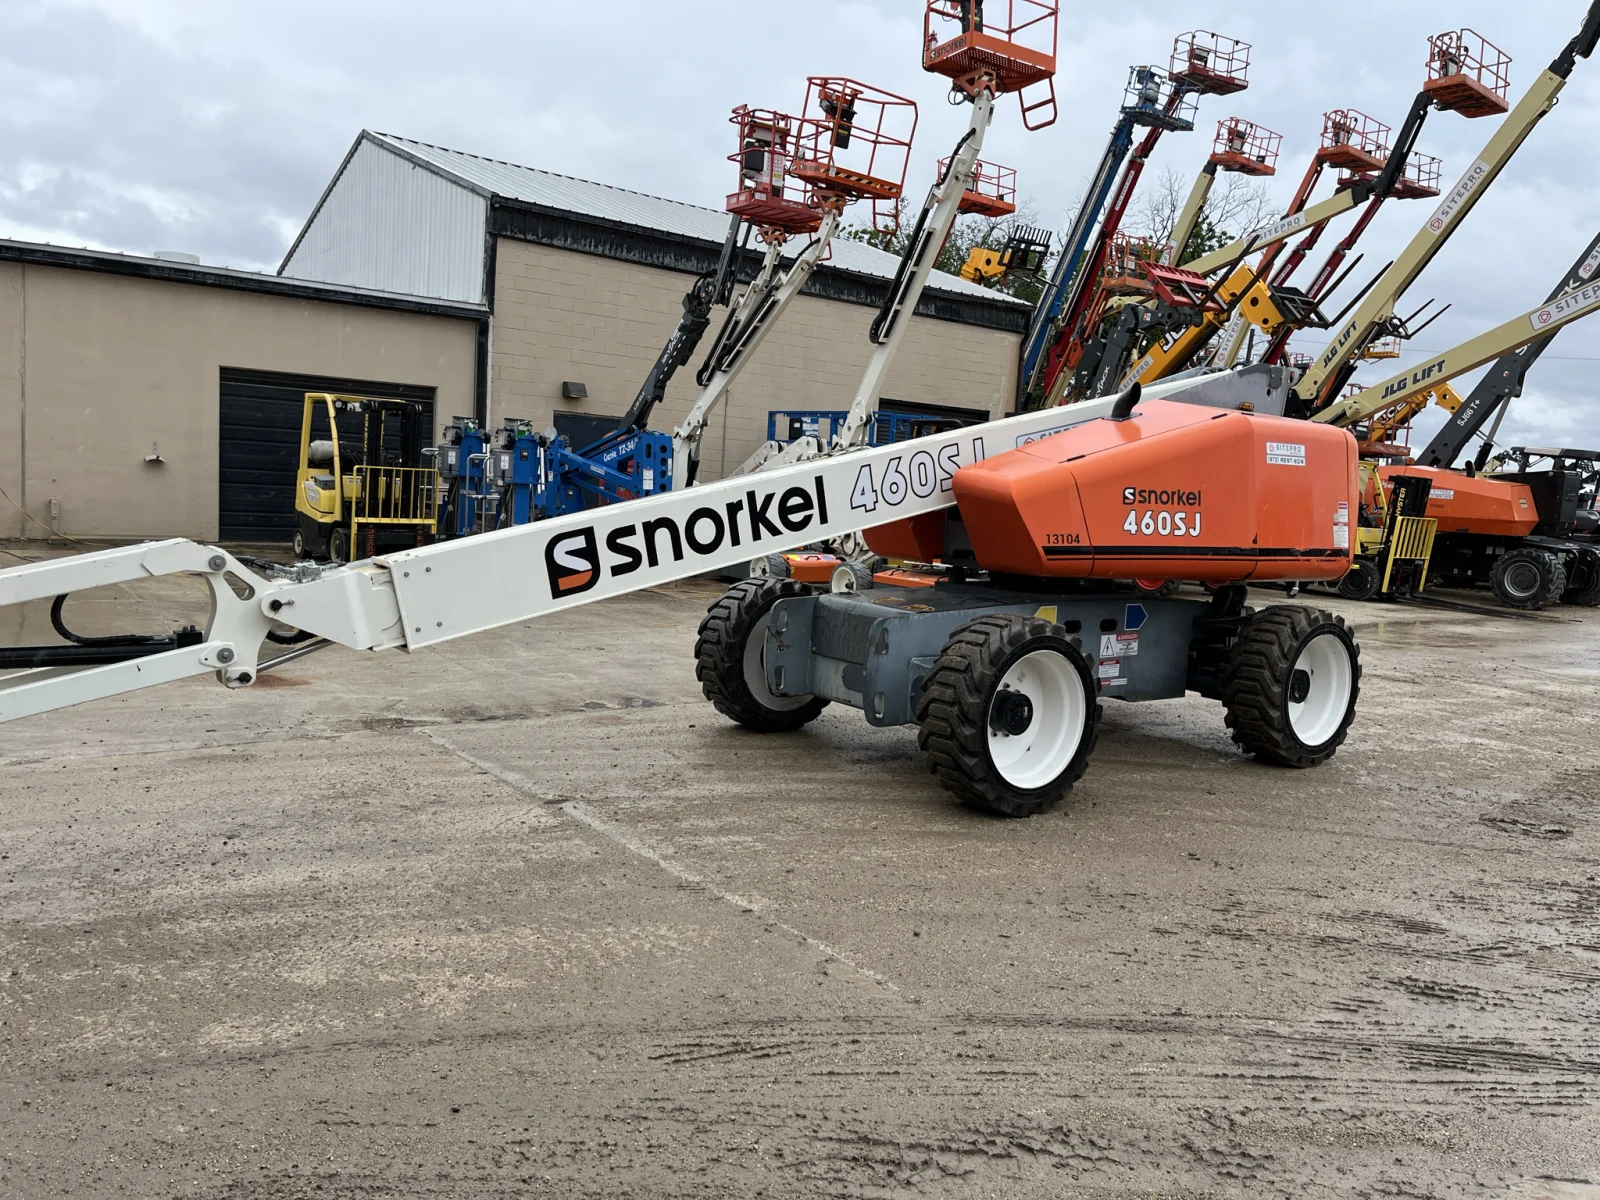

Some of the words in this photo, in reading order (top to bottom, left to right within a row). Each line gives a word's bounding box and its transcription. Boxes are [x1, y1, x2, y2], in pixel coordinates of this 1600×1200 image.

[936, 36, 967, 58] snorkel
[1441, 166, 1483, 217] SITEPRO
[1323, 345, 1338, 369] JLG
[1338, 320, 1357, 348] LIFT
[1123, 360, 1150, 390] SITEPRO
[1381, 377, 1408, 400] JLG
[1412, 359, 1446, 385] LIFT
[1457, 408, 1474, 426] SJ66
[1275, 444, 1302, 452] SITEPRO
[1138, 489, 1202, 506] snorkel
[1395, 487, 1407, 517] HYSTER
[605, 475, 829, 577] snorkel
[1122, 509, 1202, 537] 460SJ
[1045, 534, 1081, 545] 13104
